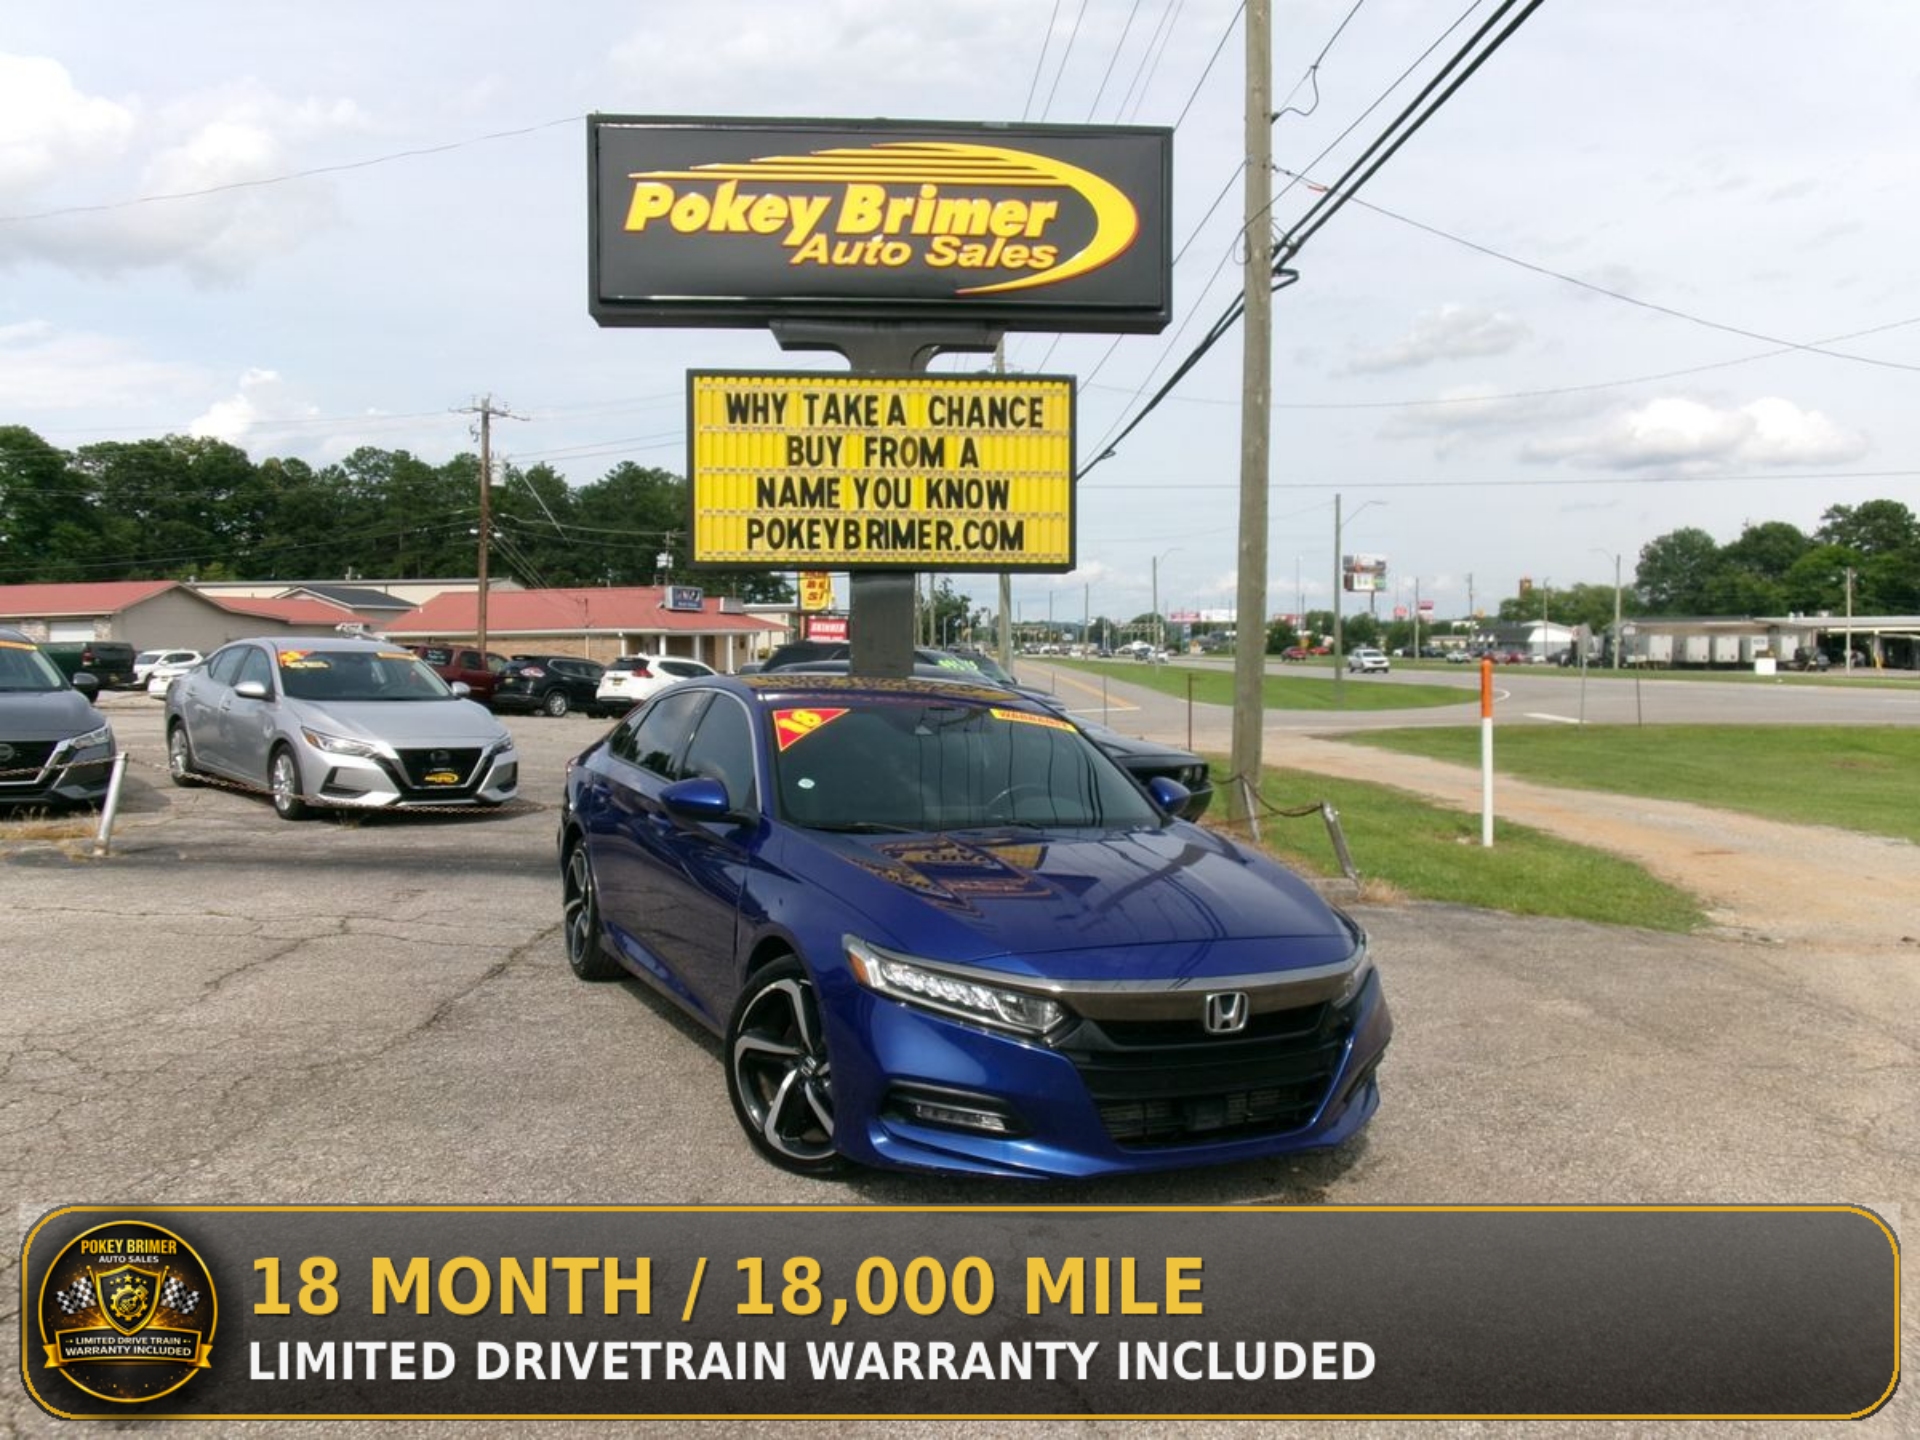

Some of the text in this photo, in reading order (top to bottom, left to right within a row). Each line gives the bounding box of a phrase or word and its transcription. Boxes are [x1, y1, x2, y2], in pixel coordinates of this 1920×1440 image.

[624, 179, 1059, 246] Pokey Brimer
[789, 232, 1059, 269] Auto Sales
[725, 393, 1044, 429] WHY TAKE A CHANCE
[785, 435, 979, 469] BUY FROM A
[755, 477, 1011, 510] NAME YOU KNOW
[746, 517, 1025, 552] POKEYBRIMER.COM
